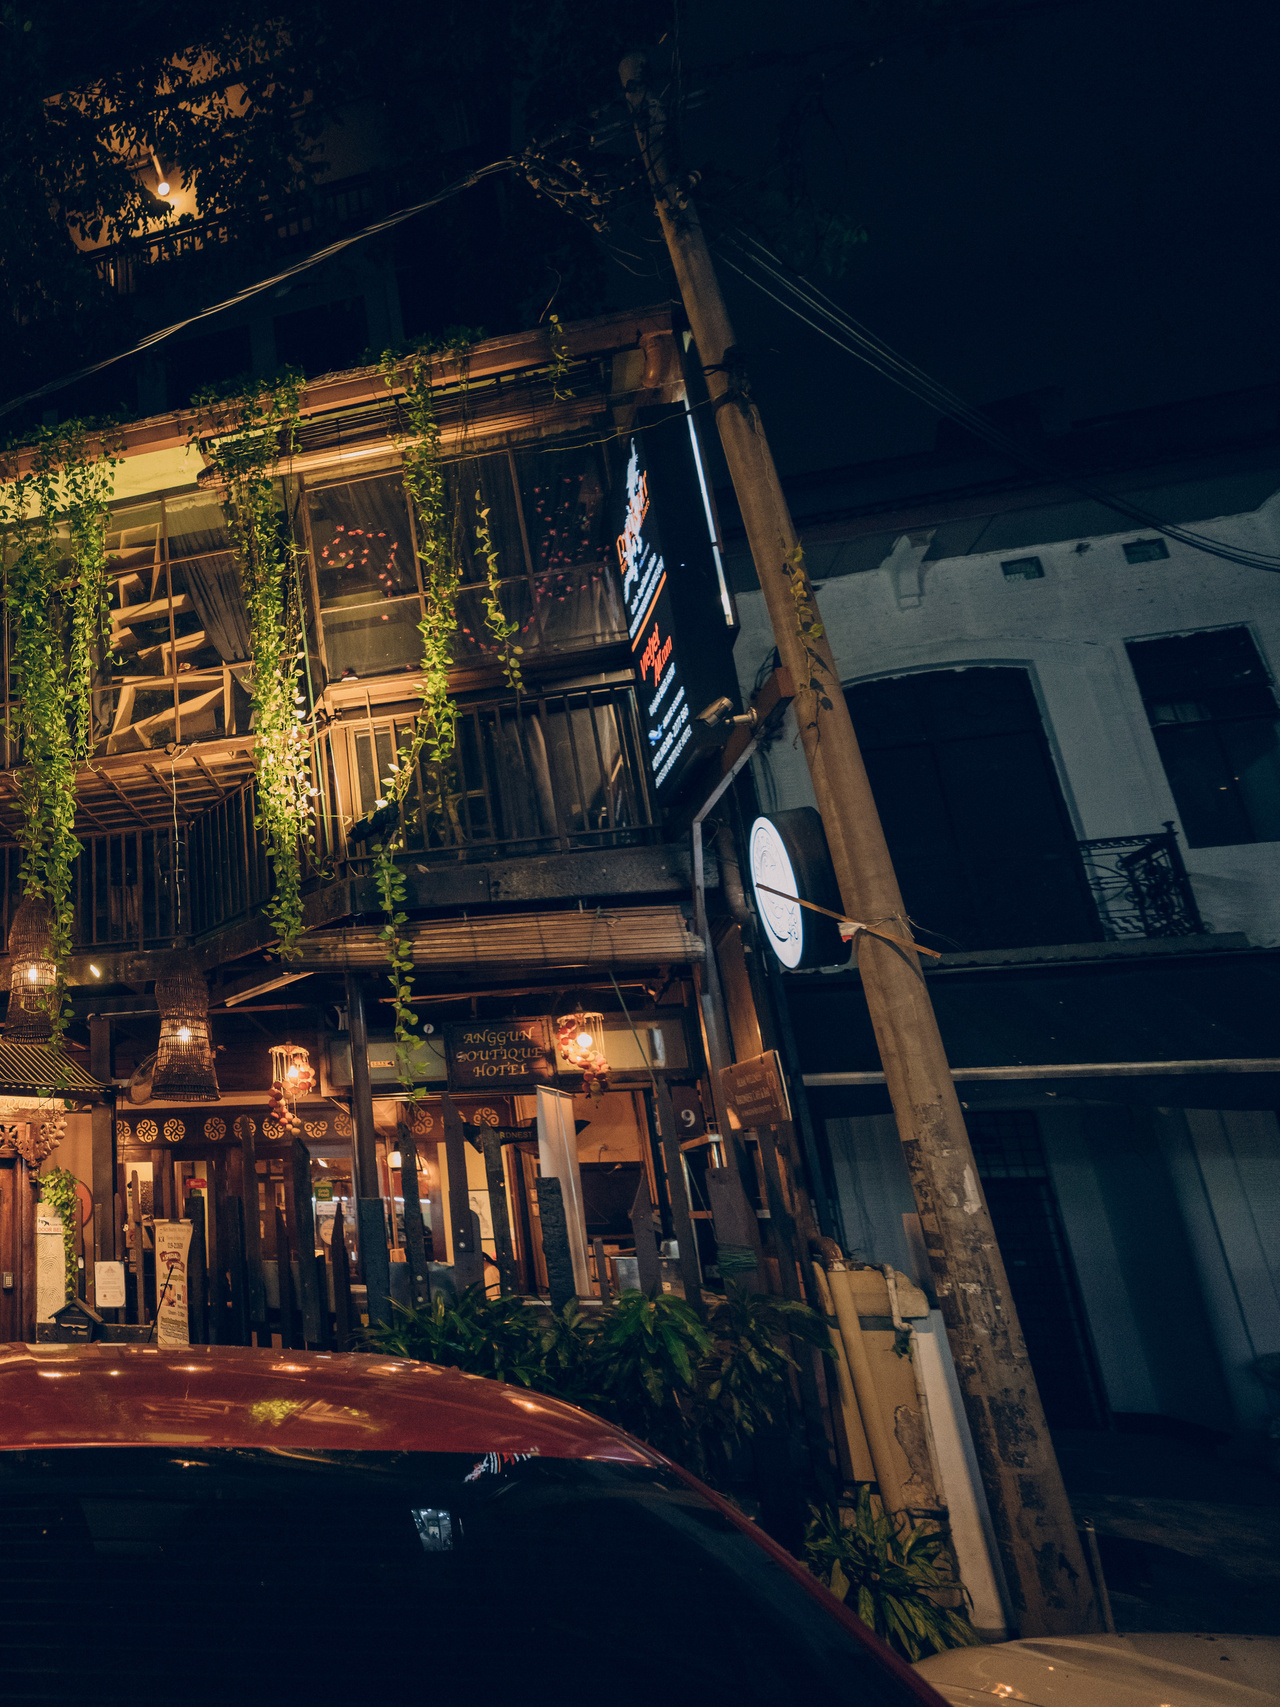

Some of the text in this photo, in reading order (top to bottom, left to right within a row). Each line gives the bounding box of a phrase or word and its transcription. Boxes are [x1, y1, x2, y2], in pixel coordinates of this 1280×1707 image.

[463, 1026, 535, 1047] ANGGUN
[473, 1062, 530, 1078] HOTEL
[681, 1109, 696, 1128] 9
